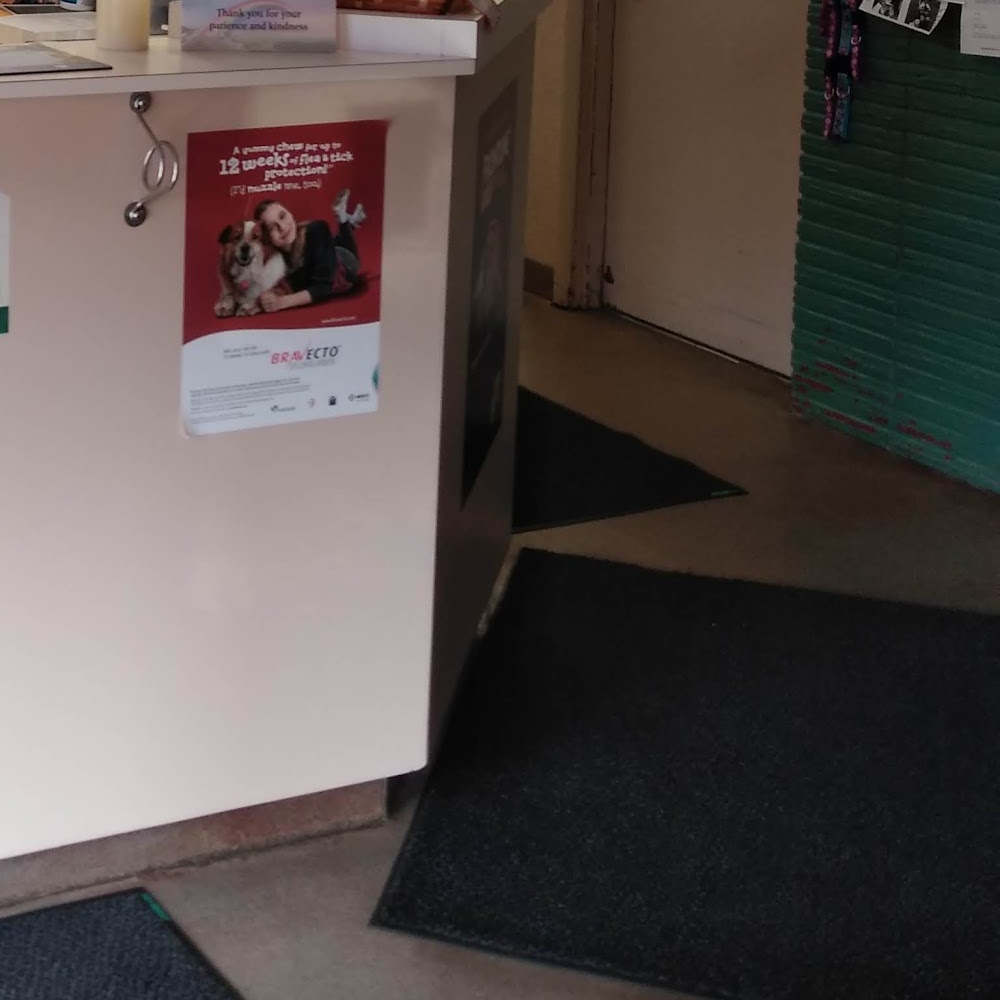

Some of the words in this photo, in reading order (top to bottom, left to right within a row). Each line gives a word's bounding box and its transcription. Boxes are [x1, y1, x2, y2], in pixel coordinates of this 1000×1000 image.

[216, 8, 245, 18] Thank
[247, 11, 264, 20] you
[266, 8, 279, 18] for
[281, 12, 302, 20] your
[209, 22, 248, 31] patience
[250, 22, 267, 30] and
[268, 21, 308, 31] kindness
[219, 157, 240, 175] 12
[242, 152, 290, 171] weeks
[330, 151, 354, 162] tick
[270, 346, 340, 365] BRAVECTO
